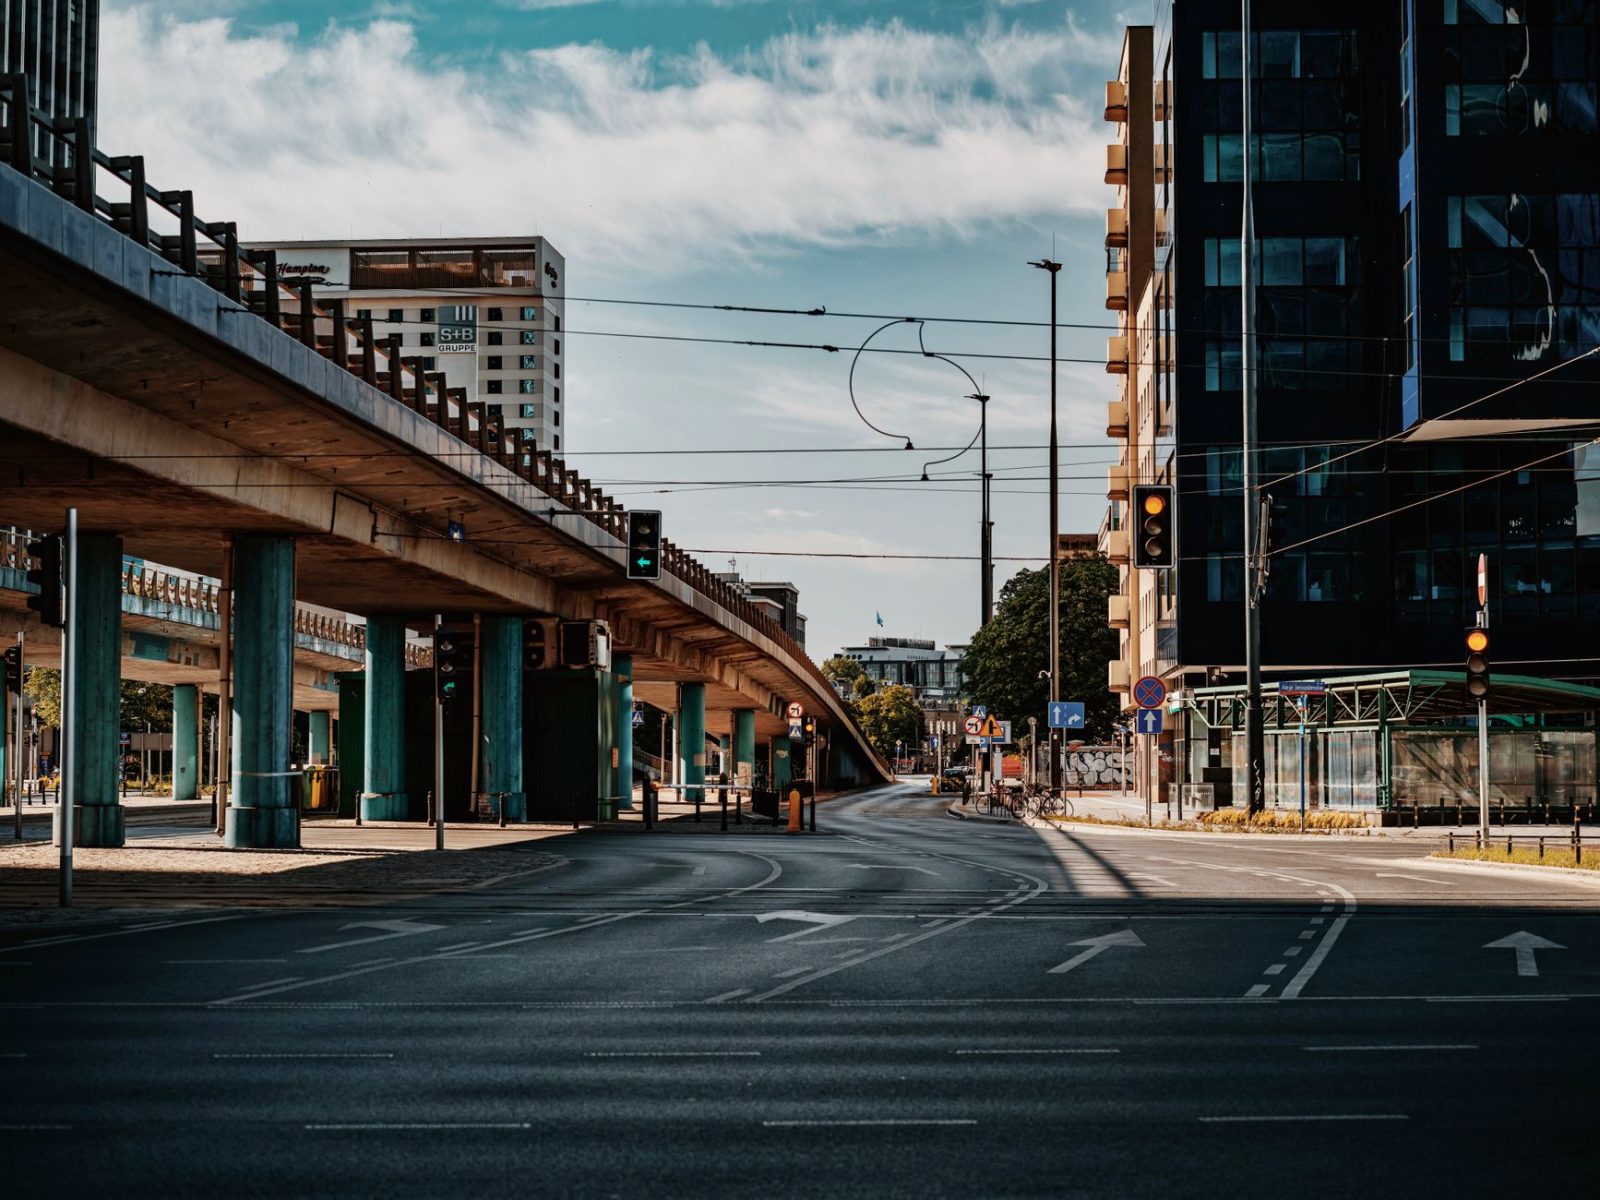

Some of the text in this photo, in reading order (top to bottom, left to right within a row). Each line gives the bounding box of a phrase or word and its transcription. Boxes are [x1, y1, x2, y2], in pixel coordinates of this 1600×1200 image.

[276, 263, 330, 275] Hampton
[440, 328, 473, 341] S+B
[438, 344, 476, 352] GRUPPE
